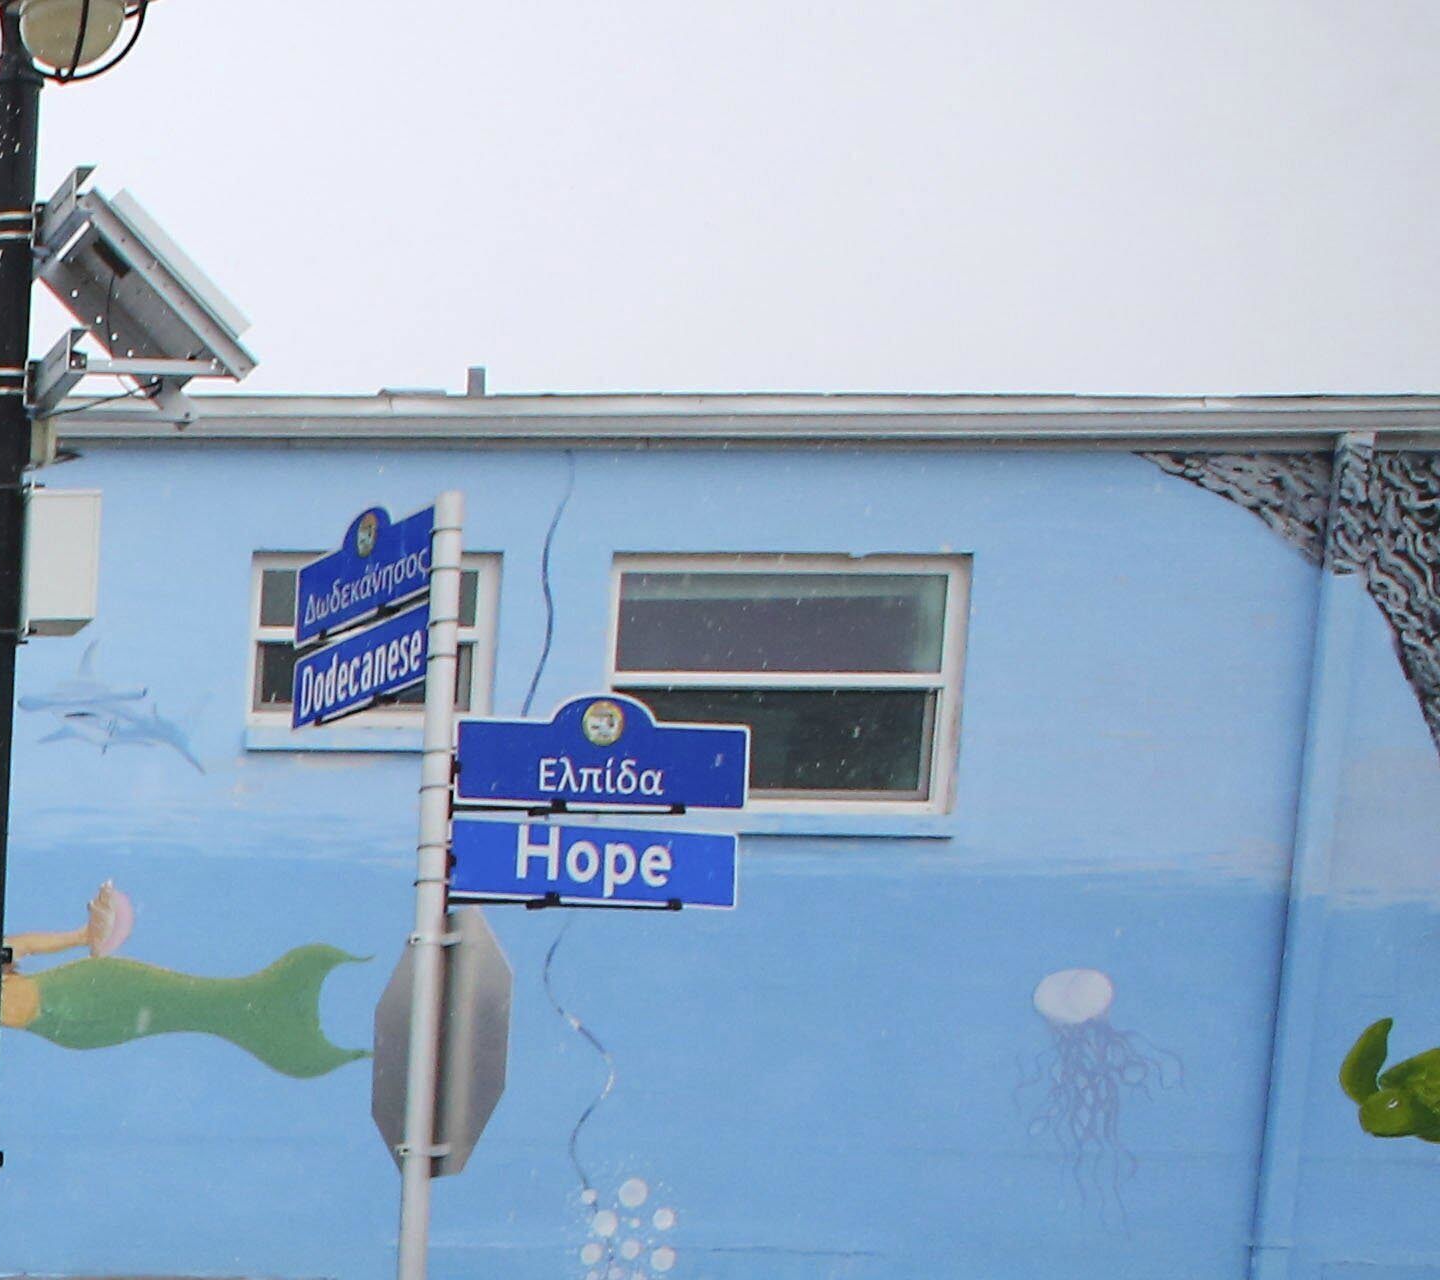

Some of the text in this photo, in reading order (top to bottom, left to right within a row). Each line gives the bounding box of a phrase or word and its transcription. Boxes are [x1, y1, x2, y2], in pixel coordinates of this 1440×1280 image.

[300, 628, 423, 719] Dodecanese
[538, 757, 665, 797] Ελπίδα
[516, 822, 672, 898] Hope
